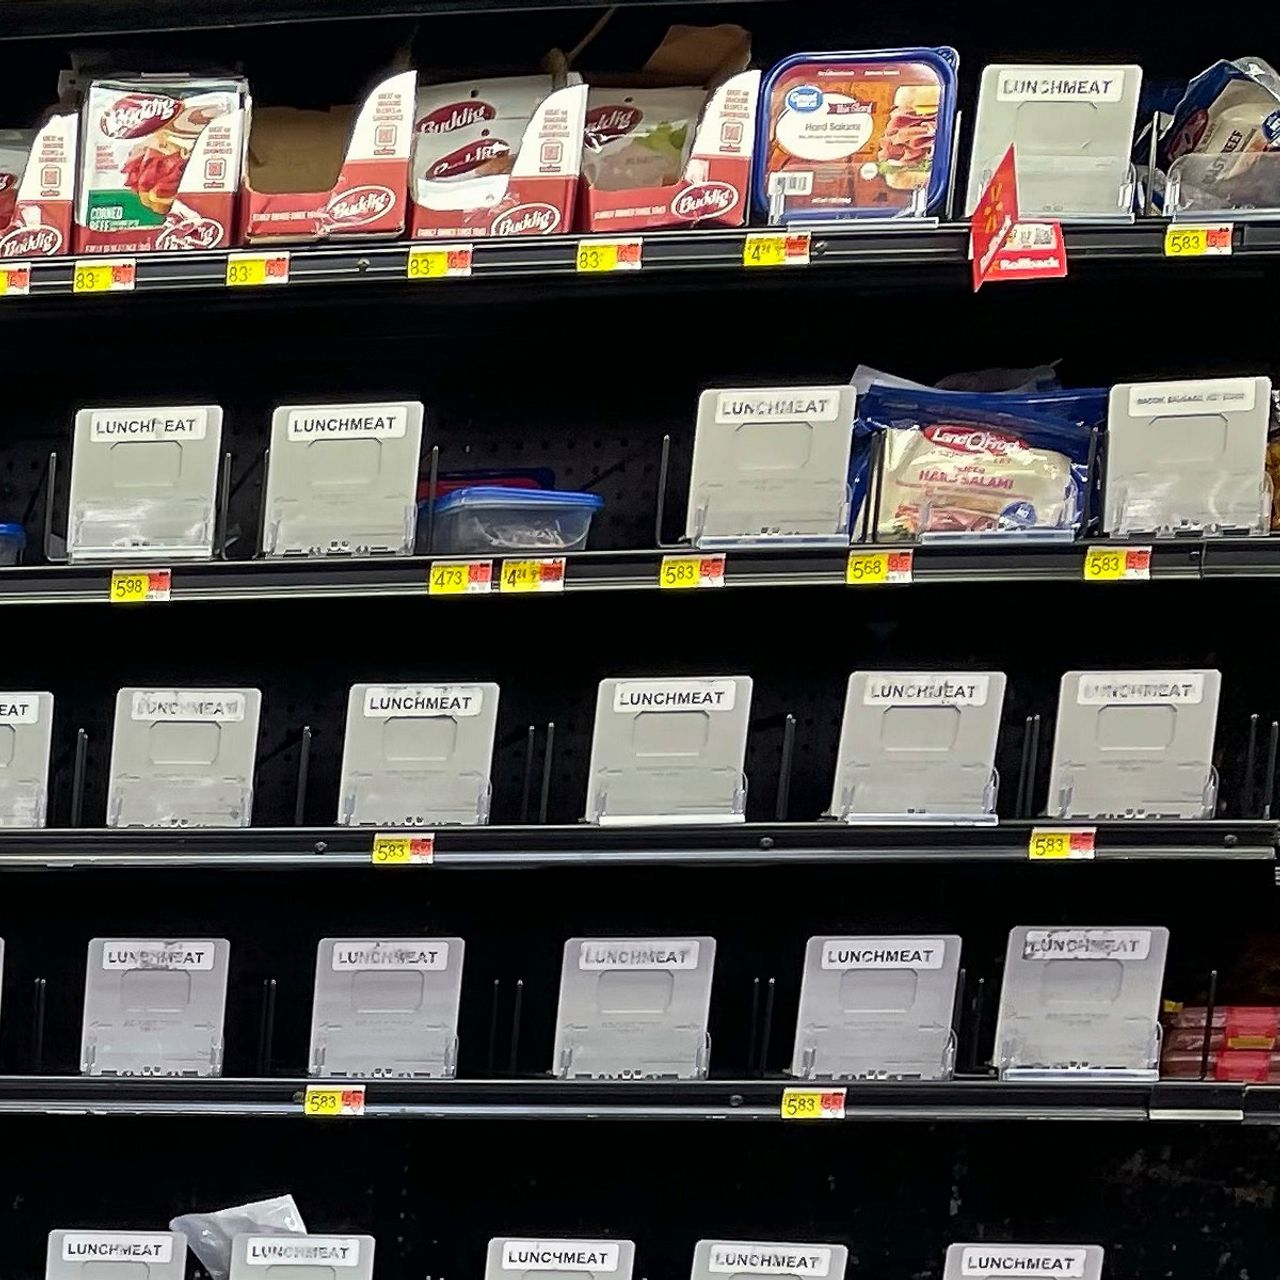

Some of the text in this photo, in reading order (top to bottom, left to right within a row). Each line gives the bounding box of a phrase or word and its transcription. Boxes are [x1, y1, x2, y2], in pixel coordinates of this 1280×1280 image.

[805, 122, 828, 131] Hard
[679, 188, 729, 213] Buddig
[500, 212, 550, 235] Buddig
[294, 417, 396, 432] LUNCHMEAT
[960, 476, 1014, 490] SALAMI
[370, 697, 471, 709] LUNCHMEAT
[620, 692, 724, 705] LUNCHMEAT
[829, 950, 933, 963] LUNCHMEAT
[68, 1244, 162, 1256] LUNCHMEAT
[969, 1257, 1075, 1270] LUNCHMEAT
